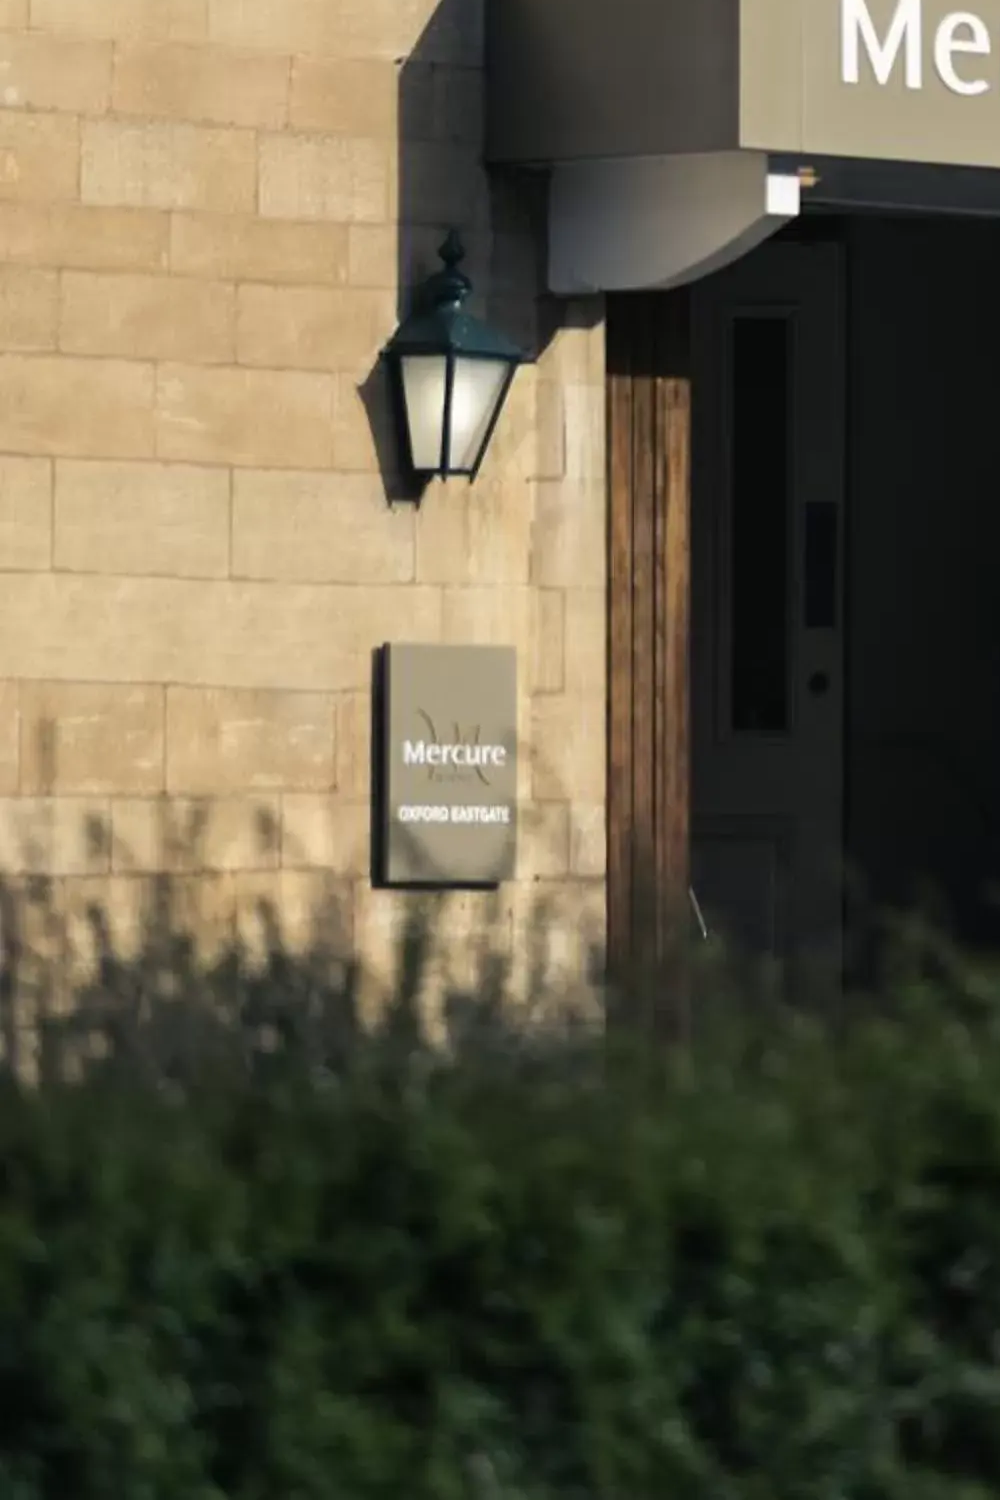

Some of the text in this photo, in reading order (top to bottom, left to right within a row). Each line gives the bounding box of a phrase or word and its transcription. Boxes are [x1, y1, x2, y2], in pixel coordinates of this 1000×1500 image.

[403, 740, 506, 766] Mercure
[399, 805, 510, 823] OXFORD EASTGATE
